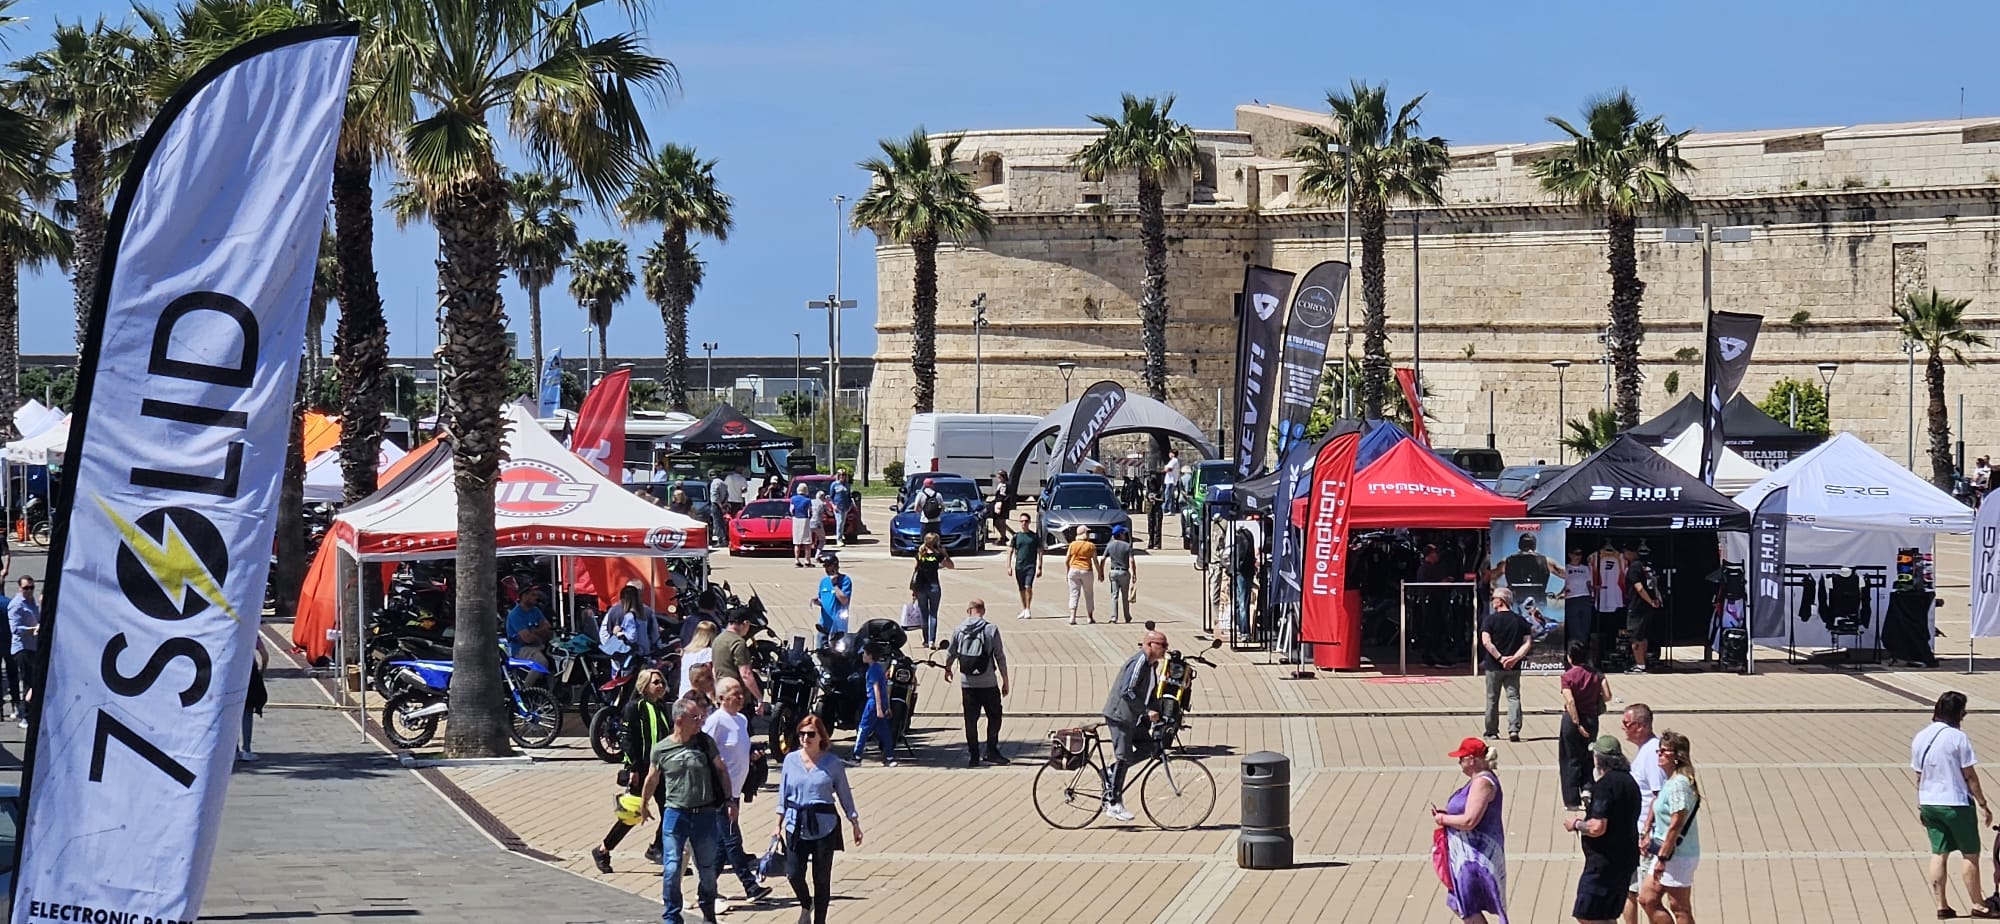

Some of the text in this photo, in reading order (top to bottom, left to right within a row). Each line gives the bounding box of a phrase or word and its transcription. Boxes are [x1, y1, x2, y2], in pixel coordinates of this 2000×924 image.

[1297, 300, 1335, 317] CORONA
[1066, 390, 1121, 465] TALARIA
[1742, 450, 1788, 459] RICAMBI
[495, 482, 595, 503] ILS
[1620, 486, 1683, 499] SHOT
[1824, 484, 1889, 496] SRG
[1574, 517, 1609, 526] SHOT
[1687, 517, 1720, 526] SHOT
[1909, 516, 1944, 525] SRG
[510, 532, 629, 543] LUBRICANTS
[650, 533, 687, 545] NILS
[1761, 520, 1775, 574] SHOT
[1980, 526, 1996, 594] SRG
[1530, 661, 1565, 671] Repeat.
[29, 901, 139, 924] ELECTRONIC
